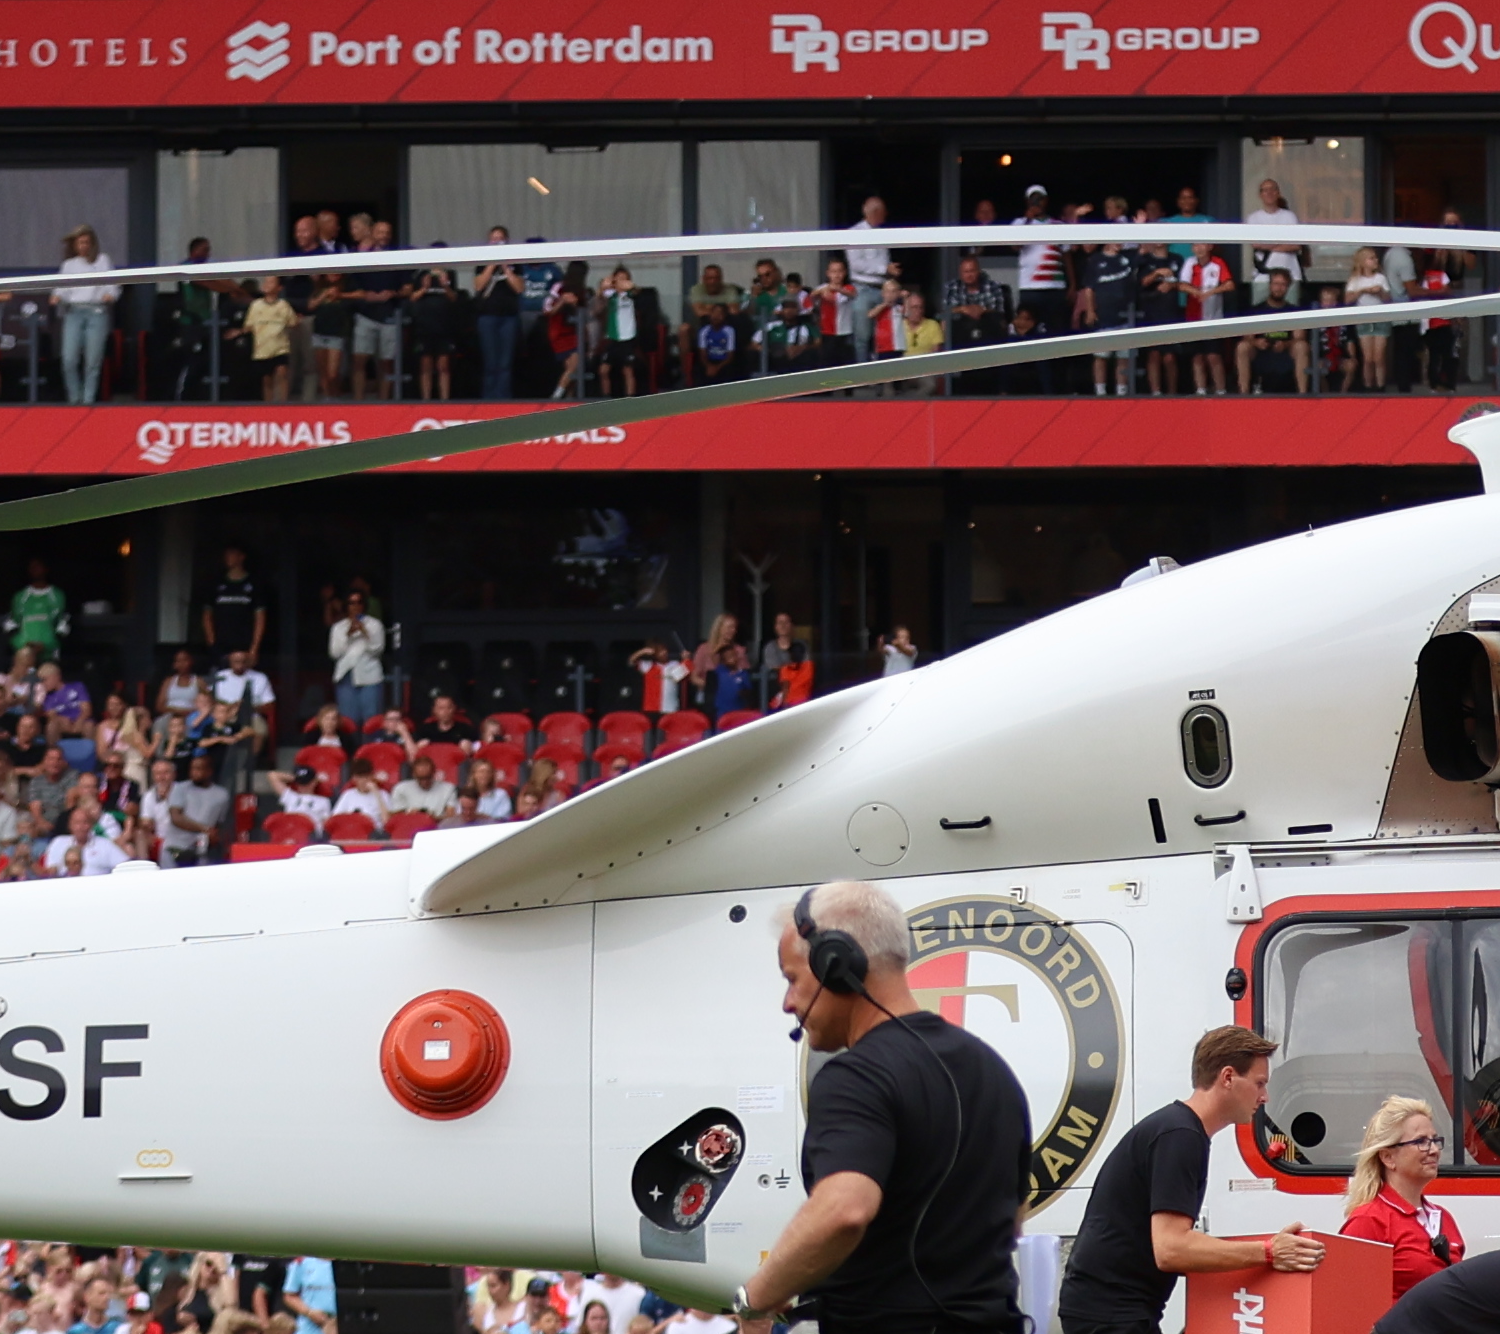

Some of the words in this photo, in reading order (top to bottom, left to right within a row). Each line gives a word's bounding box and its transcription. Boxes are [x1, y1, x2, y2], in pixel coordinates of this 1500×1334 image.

[309, 30, 402, 67] Port
[412, 26, 462, 66] of
[474, 24, 713, 64] Rotterdam
[845, 28, 990, 54] GROUP
[1115, 26, 1261, 51] GROUP
[912, 907, 1102, 1009] ENOORD
